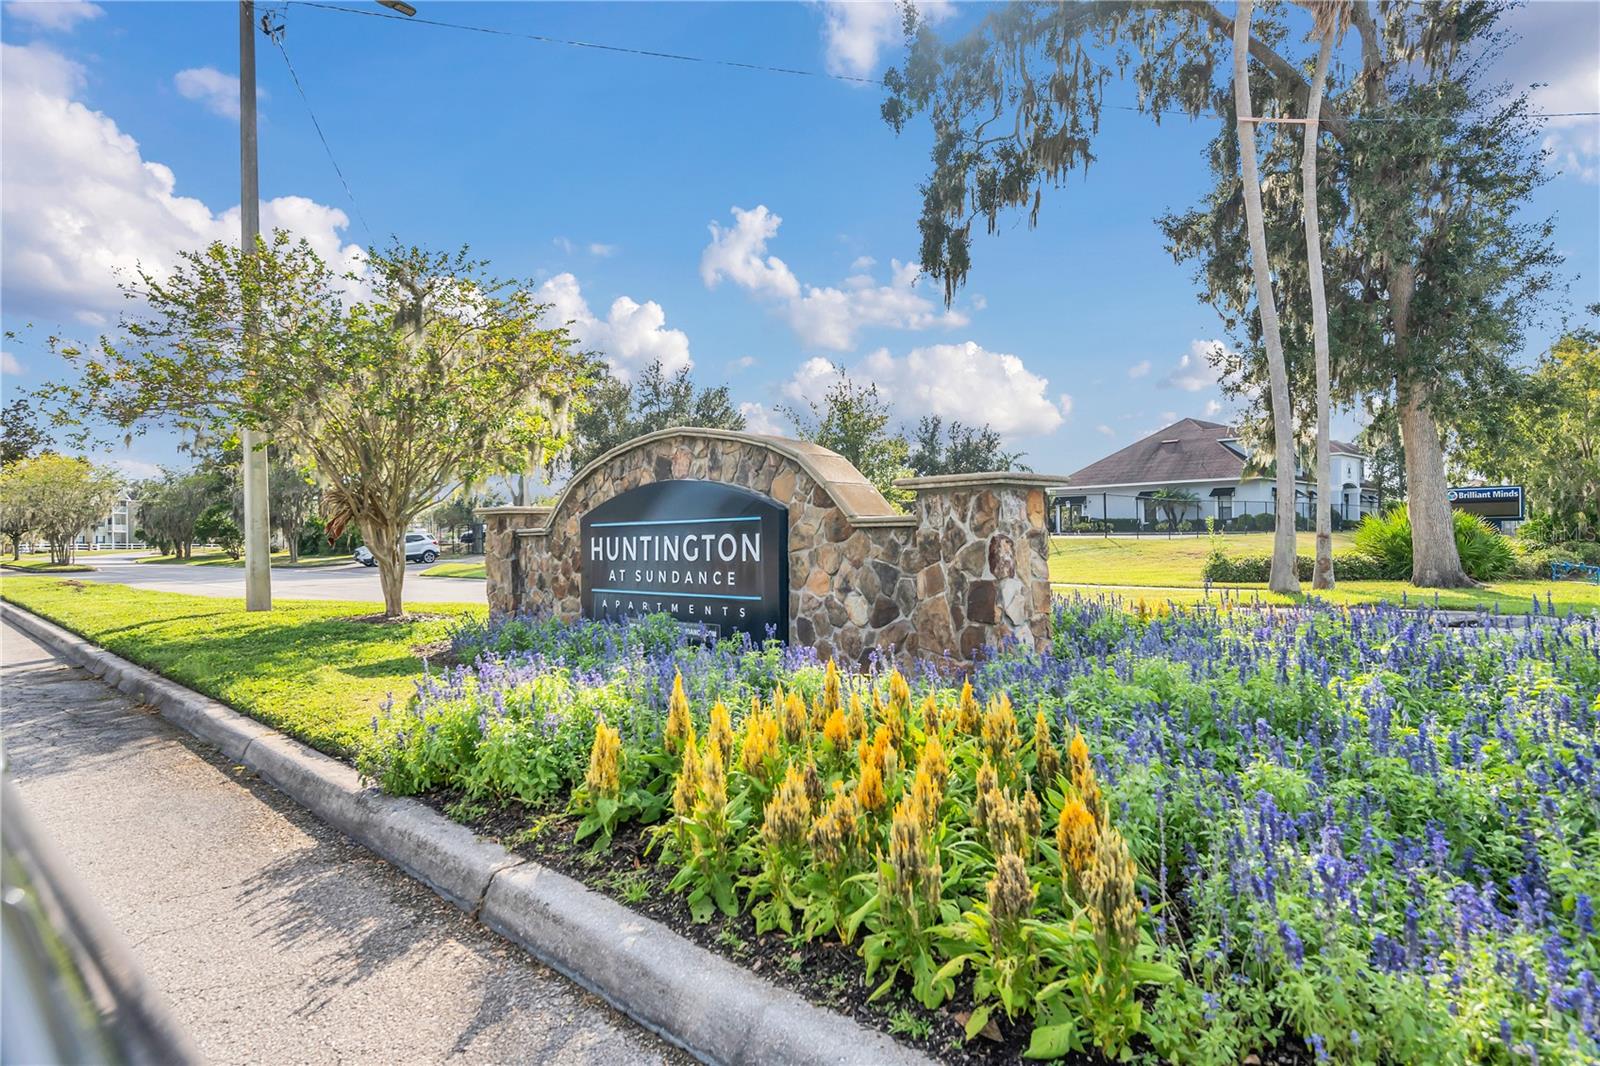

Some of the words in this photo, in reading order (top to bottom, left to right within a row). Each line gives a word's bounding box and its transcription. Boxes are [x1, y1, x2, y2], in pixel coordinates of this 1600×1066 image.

[1458, 491, 1491, 499] Brilliant
[1492, 490, 1519, 498] Minds
[590, 533, 761, 562] HUNTINGTON
[608, 569, 626, 582] AT
[635, 570, 736, 585] SUNDANCE
[602, 600, 746, 617] APARTMENTS
